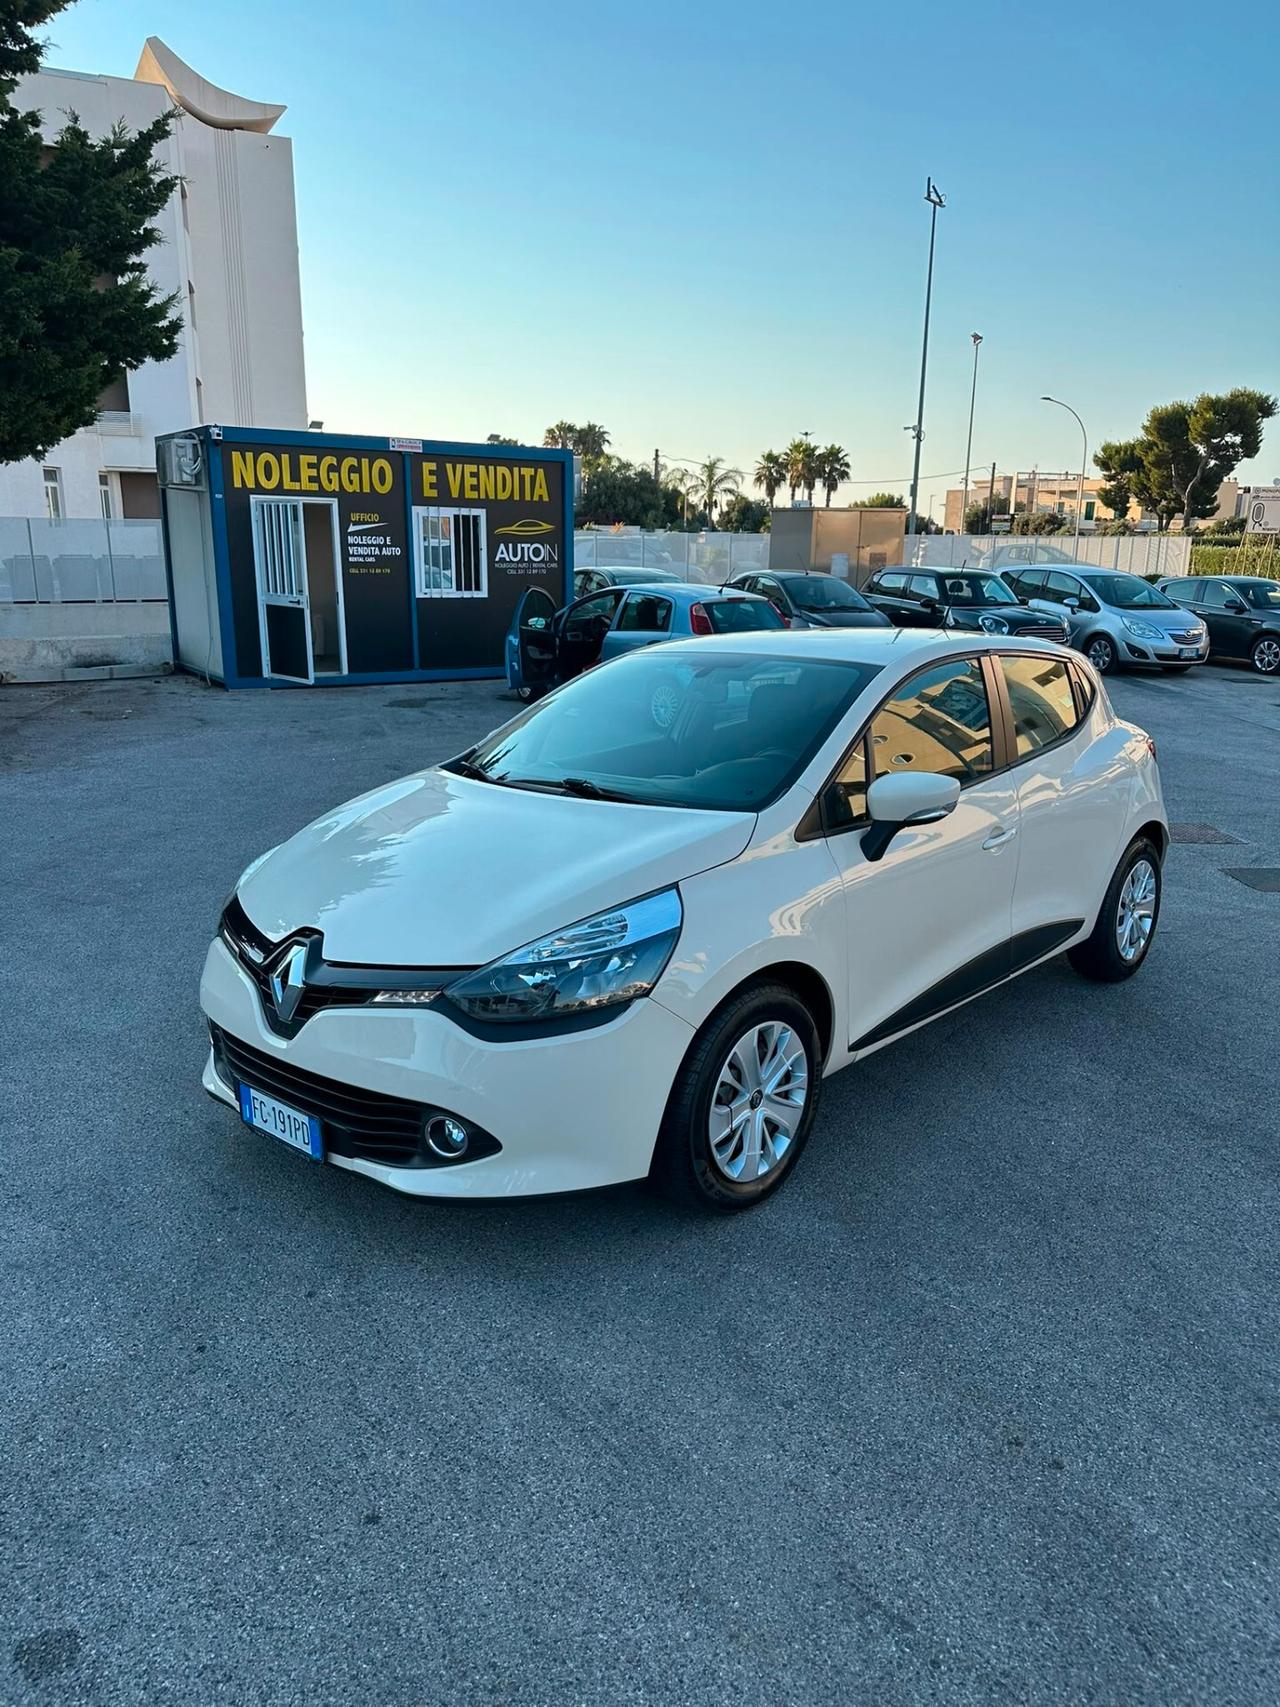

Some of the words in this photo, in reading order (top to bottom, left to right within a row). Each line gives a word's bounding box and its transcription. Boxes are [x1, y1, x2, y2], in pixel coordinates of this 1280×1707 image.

[231, 451, 393, 494] NOLEGGIO
[422, 461, 438, 497] E
[445, 463, 549, 502] VENDITA
[350, 512, 380, 522] UFFICIO
[347, 536, 385, 545] NOLEGGIO
[386, 536, 392, 545] E
[348, 546, 380, 555] VENDITA
[381, 547, 401, 556] AUTO
